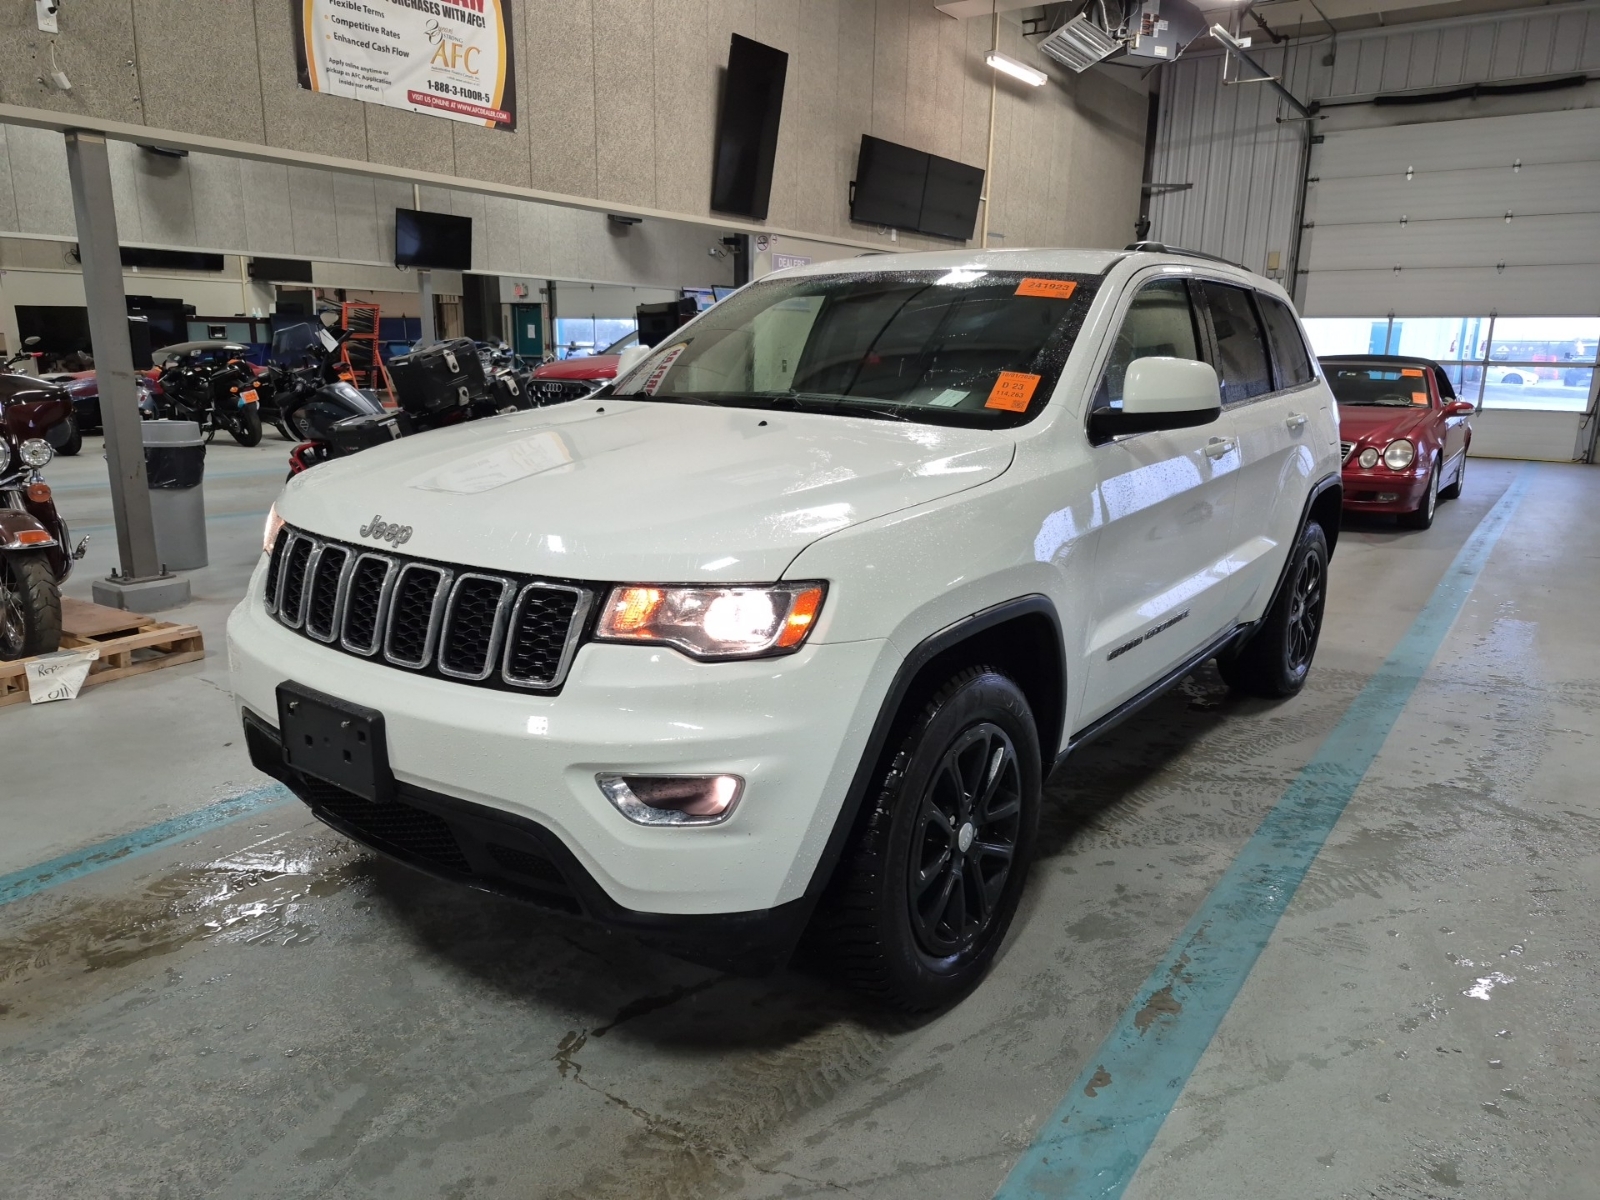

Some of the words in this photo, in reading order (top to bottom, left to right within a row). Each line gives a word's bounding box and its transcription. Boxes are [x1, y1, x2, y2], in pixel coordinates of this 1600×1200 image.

[362, 4, 385, 19] Terms
[441, 4, 467, 24] WITH
[466, 11, 486, 29] AFC!
[331, 14, 380, 34] Competitive
[380, 26, 401, 40] Rates
[333, 31, 370, 49] Enhanced
[371, 42, 391, 55] Cash
[391, 46, 410, 58] Flow
[328, 57, 344, 67] Apply
[430, 39, 482, 75] AFC
[326, 67, 345, 76] pickup
[351, 72, 361, 80] AFC
[361, 75, 392, 86] Application
[411, 92, 424, 101] VISIT
[424, 95, 432, 104] US
[431, 98, 450, 108] ONLINE
[427, 79, 490, 103] 1-888-3-FLOOR-5
[778, 257, 805, 268] DEALERS
[1002, 381, 1010, 389] D
[1011, 383, 1025, 391] 23
[360, 514, 414, 549] Jeep
